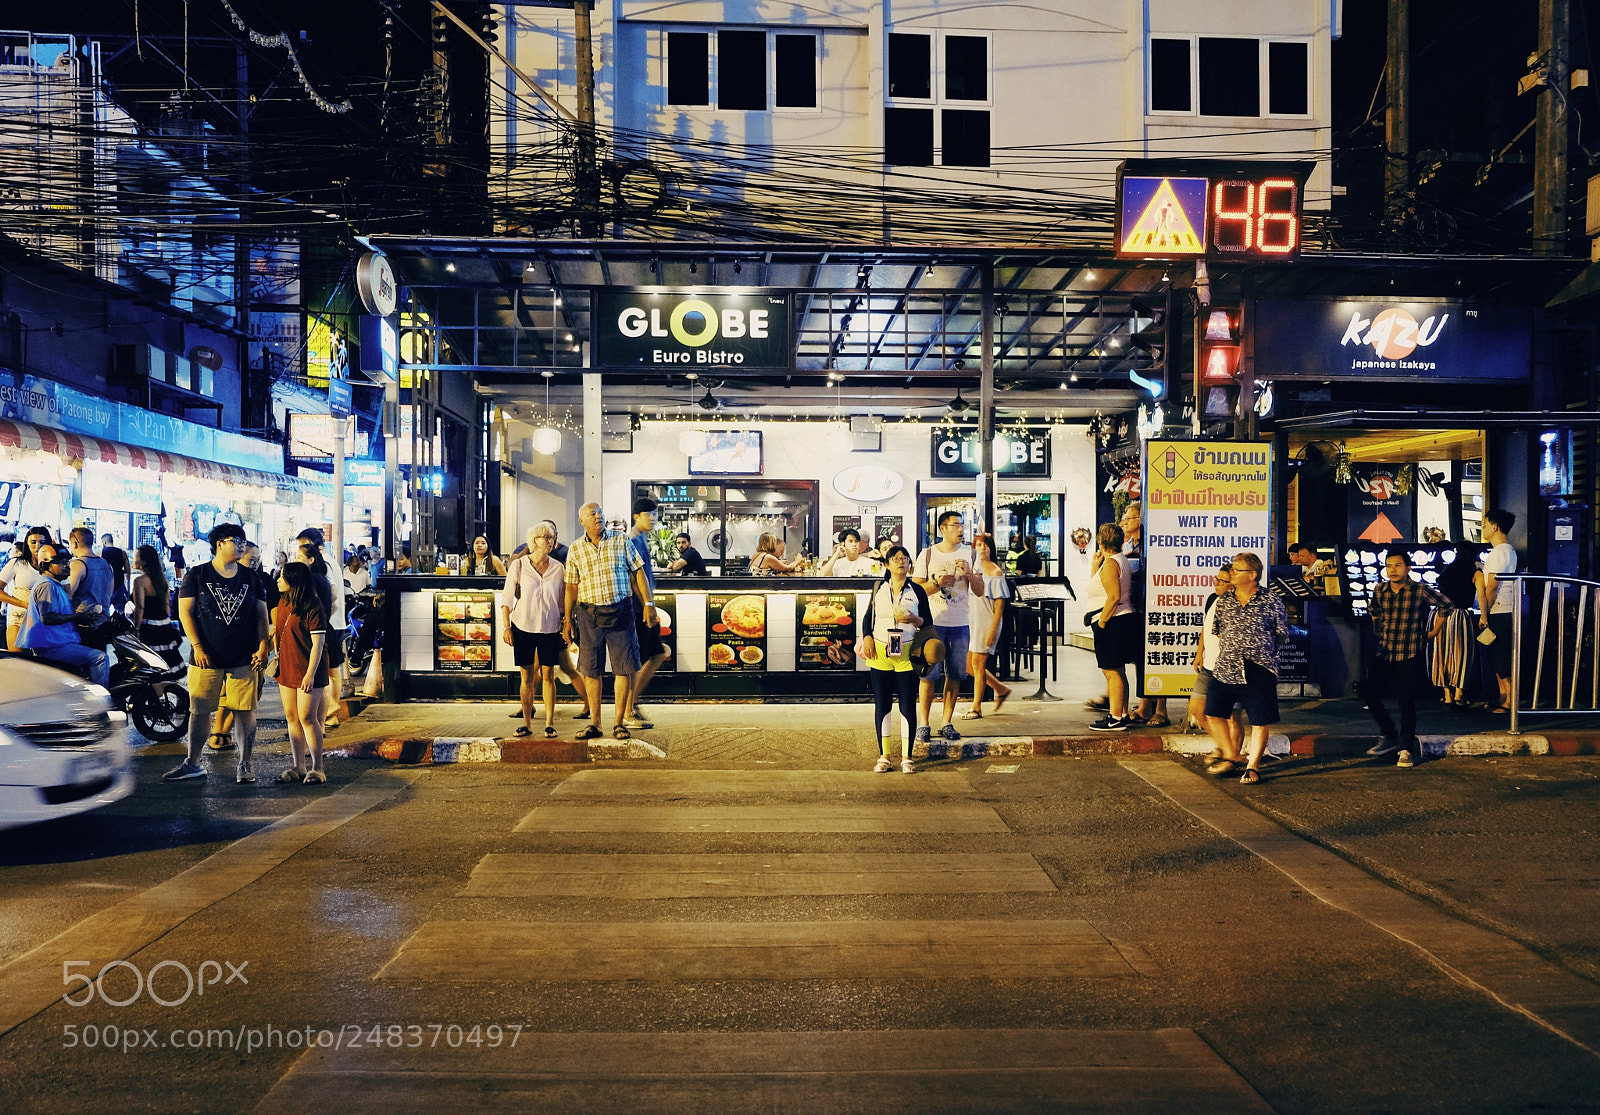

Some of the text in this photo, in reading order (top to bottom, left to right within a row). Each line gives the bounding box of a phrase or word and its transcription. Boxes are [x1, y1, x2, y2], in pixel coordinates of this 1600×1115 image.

[1215, 180, 1296, 253] 46
[617, 300, 769, 347] GLOBE
[1340, 311, 1449, 359] KAZU
[653, 350, 744, 364] Euro Bistro
[20, 387, 47, 411] view
[48, 397, 61, 413] of
[62, 402, 93, 425] Patong
[95, 408, 111, 428] bay
[143, 414, 166, 441] Pan
[1194, 446, 1266, 466] ข้ามถนน
[1193, 470, 1267, 482] ให้รอสัญญาณไฟ
[1150, 487, 1266, 506] ฝ่าฝืนมีโทษปรับ
[1178, 515, 1238, 528] WAIT FOR
[1149, 535, 1266, 549] PEDESTRIAN LIGHT
[1176, 555, 1191, 567] TO
[1157, 594, 1205, 607] RESULT
[1148, 611, 1204, 627] 穿过街道
[1147, 632, 1202, 646] 等待灯光
